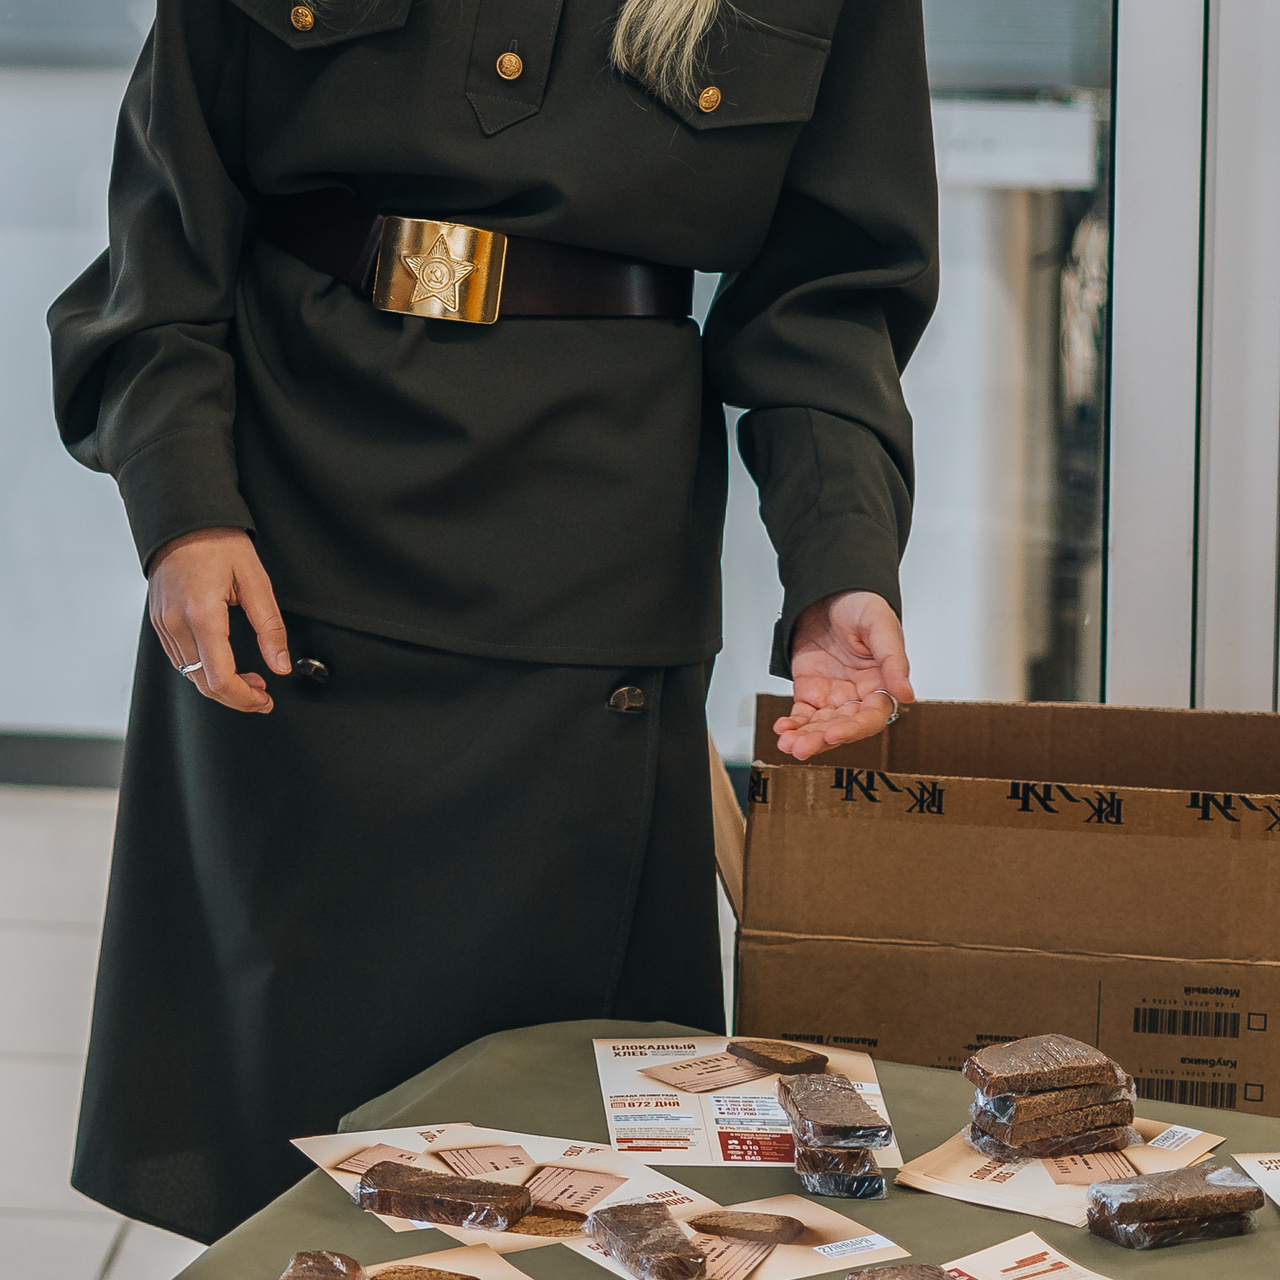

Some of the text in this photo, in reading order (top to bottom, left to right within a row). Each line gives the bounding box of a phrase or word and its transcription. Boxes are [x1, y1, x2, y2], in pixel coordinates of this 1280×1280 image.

[1183, 986, 1240, 998] Медовый
[612, 1043, 696, 1051] БЛОКАДНЫЙ
[832, 1034, 878, 1048] Малина
[1180, 1057, 1238, 1069] Клубника
